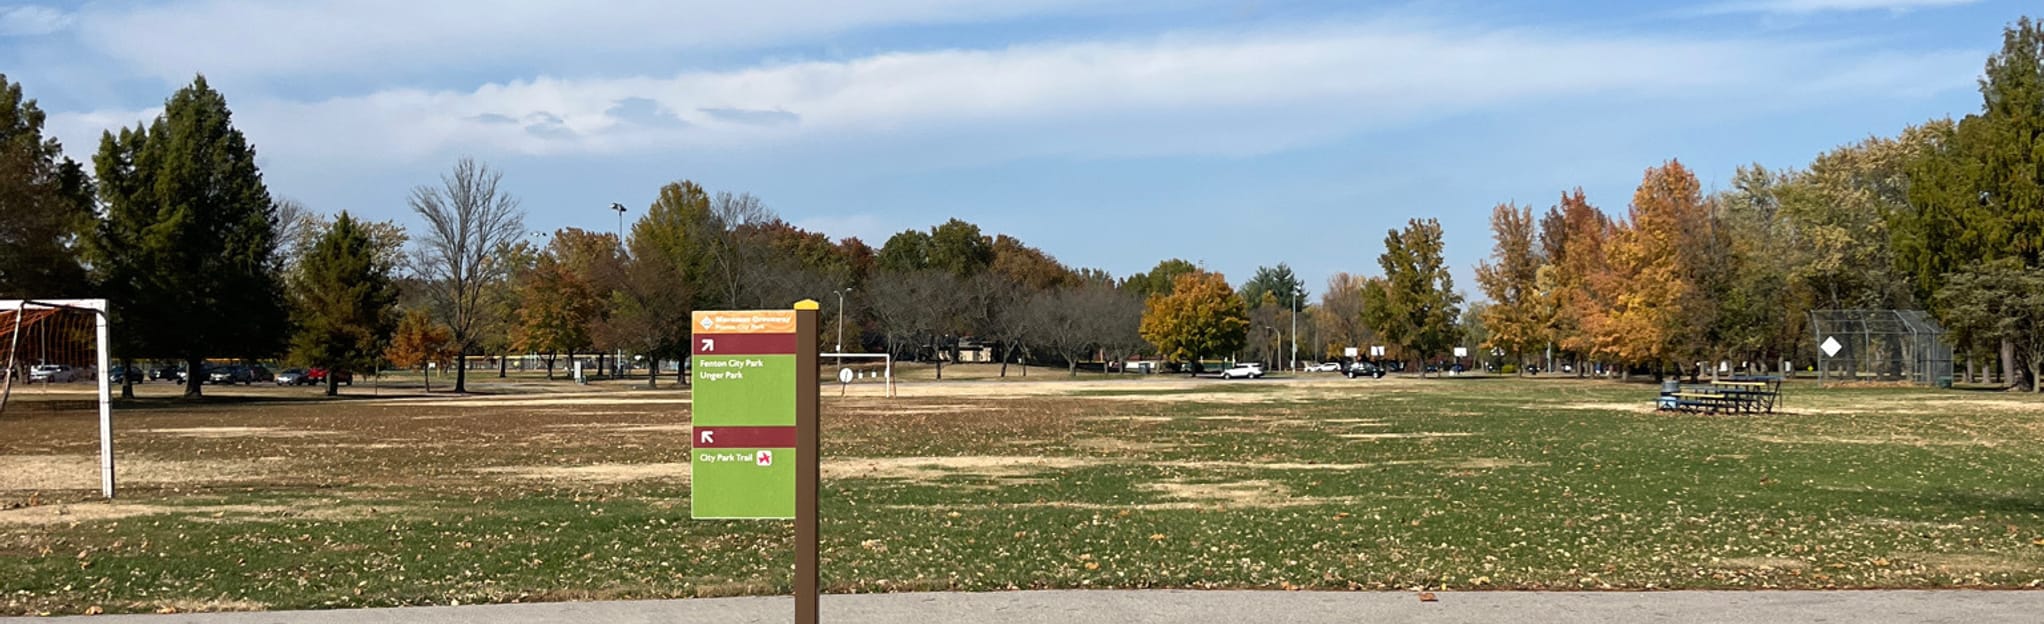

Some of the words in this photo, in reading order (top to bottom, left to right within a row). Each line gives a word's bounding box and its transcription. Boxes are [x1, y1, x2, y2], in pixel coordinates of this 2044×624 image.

[700, 360, 727, 368] Fenton
[728, 360, 744, 368] City
[745, 359, 764, 367] Park
[700, 372, 724, 380] Unger
[700, 454, 716, 463] City
[717, 454, 734, 462] Park
[736, 454, 752, 462] Trail
